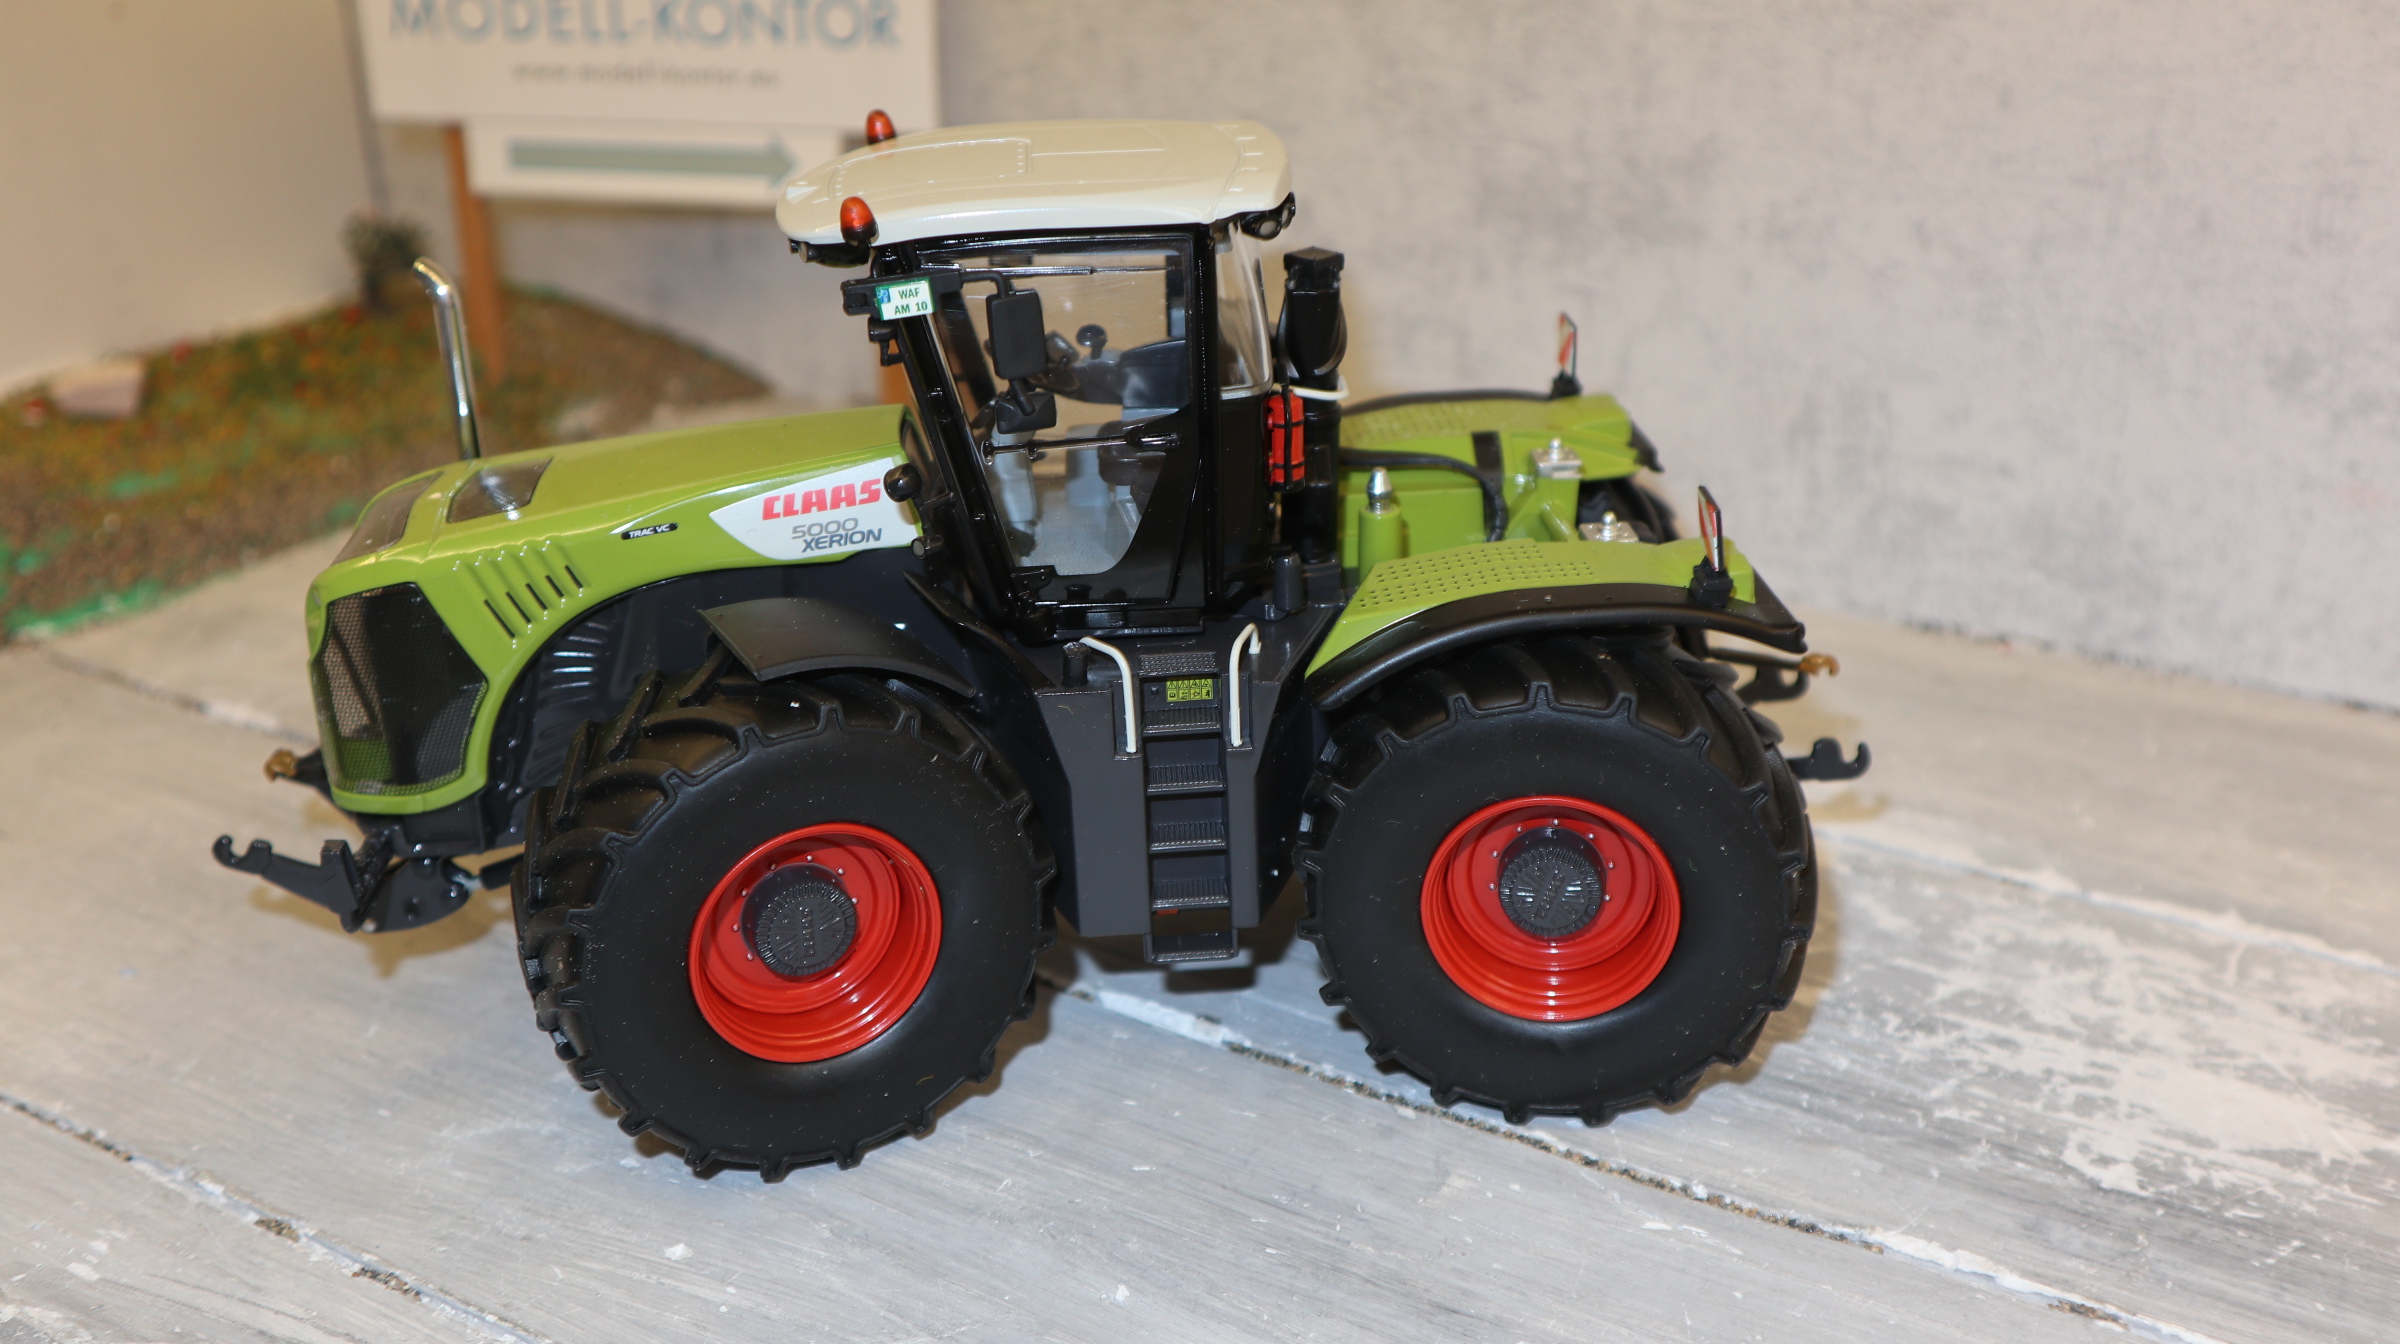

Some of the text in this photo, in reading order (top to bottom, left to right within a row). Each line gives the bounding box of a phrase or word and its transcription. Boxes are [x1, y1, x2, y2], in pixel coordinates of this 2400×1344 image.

[388, 0, 902, 47] MODELL-KONTOR
[897, 287, 920, 300] WAF
[894, 300, 928, 315] AM 10
[763, 479, 881, 520] CLAAS
[629, 524, 670, 538] TRAC VC
[791, 517, 859, 539] 5000
[802, 528, 882, 552] XERION
